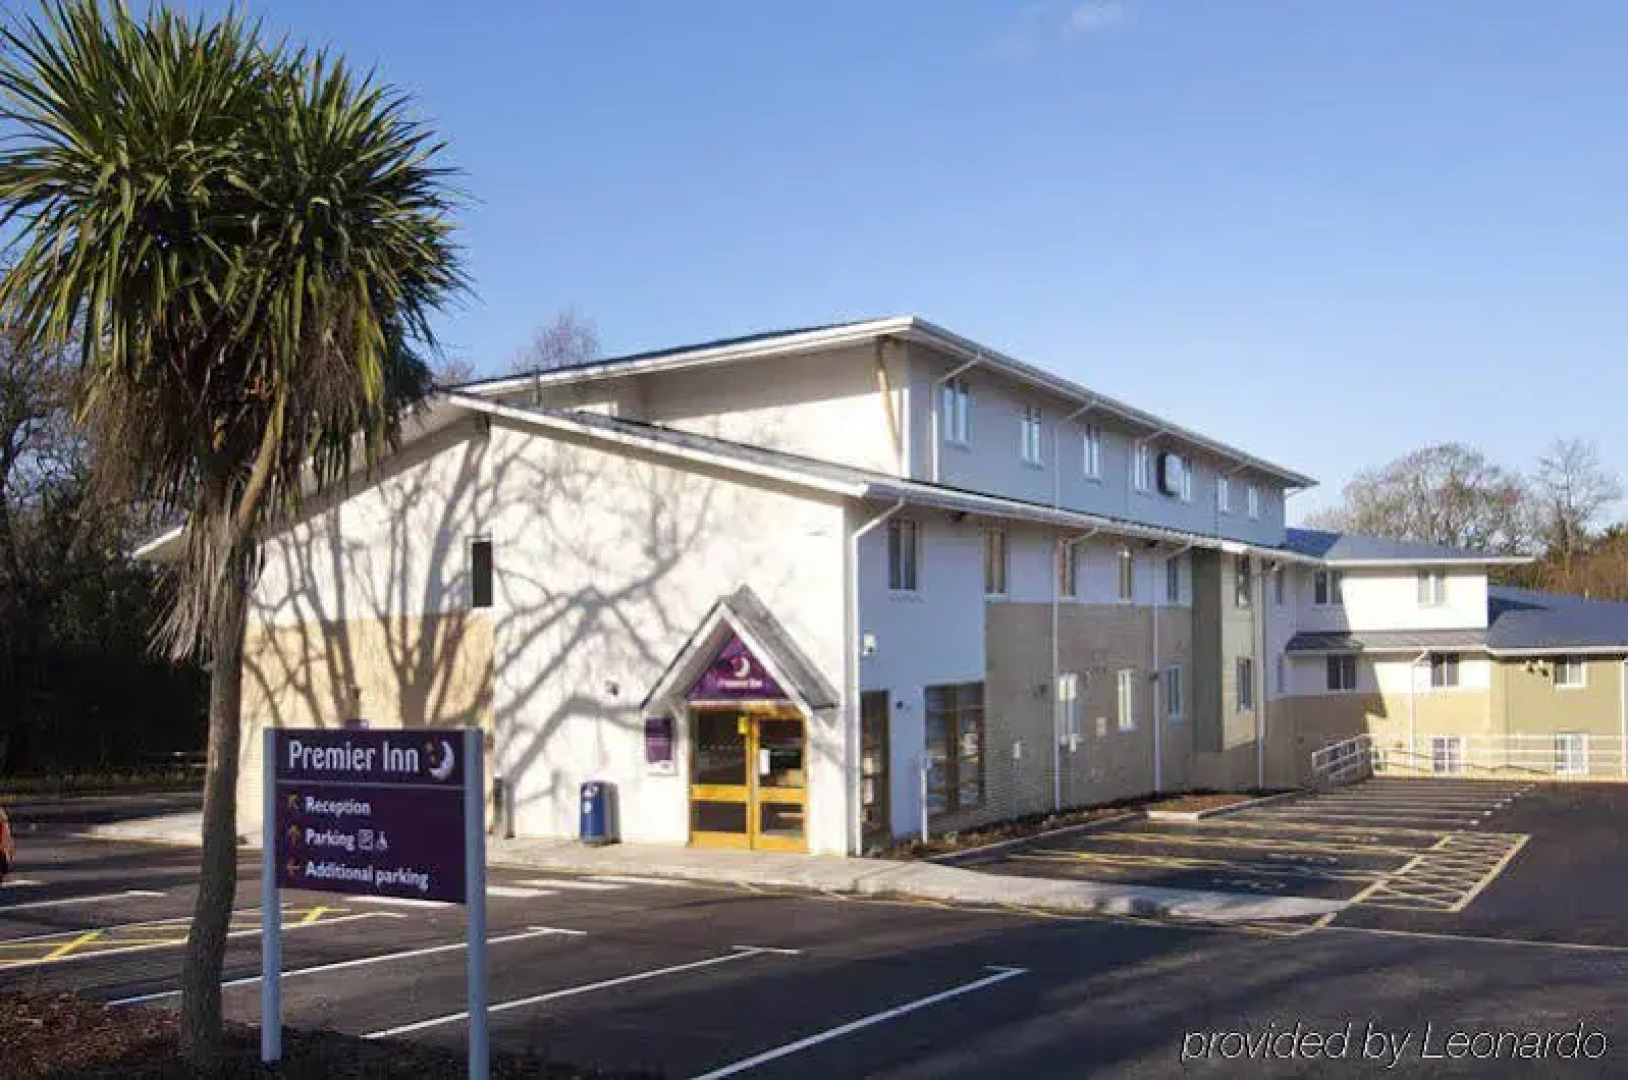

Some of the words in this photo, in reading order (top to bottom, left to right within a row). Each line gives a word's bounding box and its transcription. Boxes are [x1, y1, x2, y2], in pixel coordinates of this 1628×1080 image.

[288, 740, 376, 772] Premier
[382, 740, 419, 773] Inn
[305, 796, 371, 817] Reception
[305, 828, 355, 851] Parking
[305, 861, 374, 882] Additional
[375, 868, 429, 892] parking
